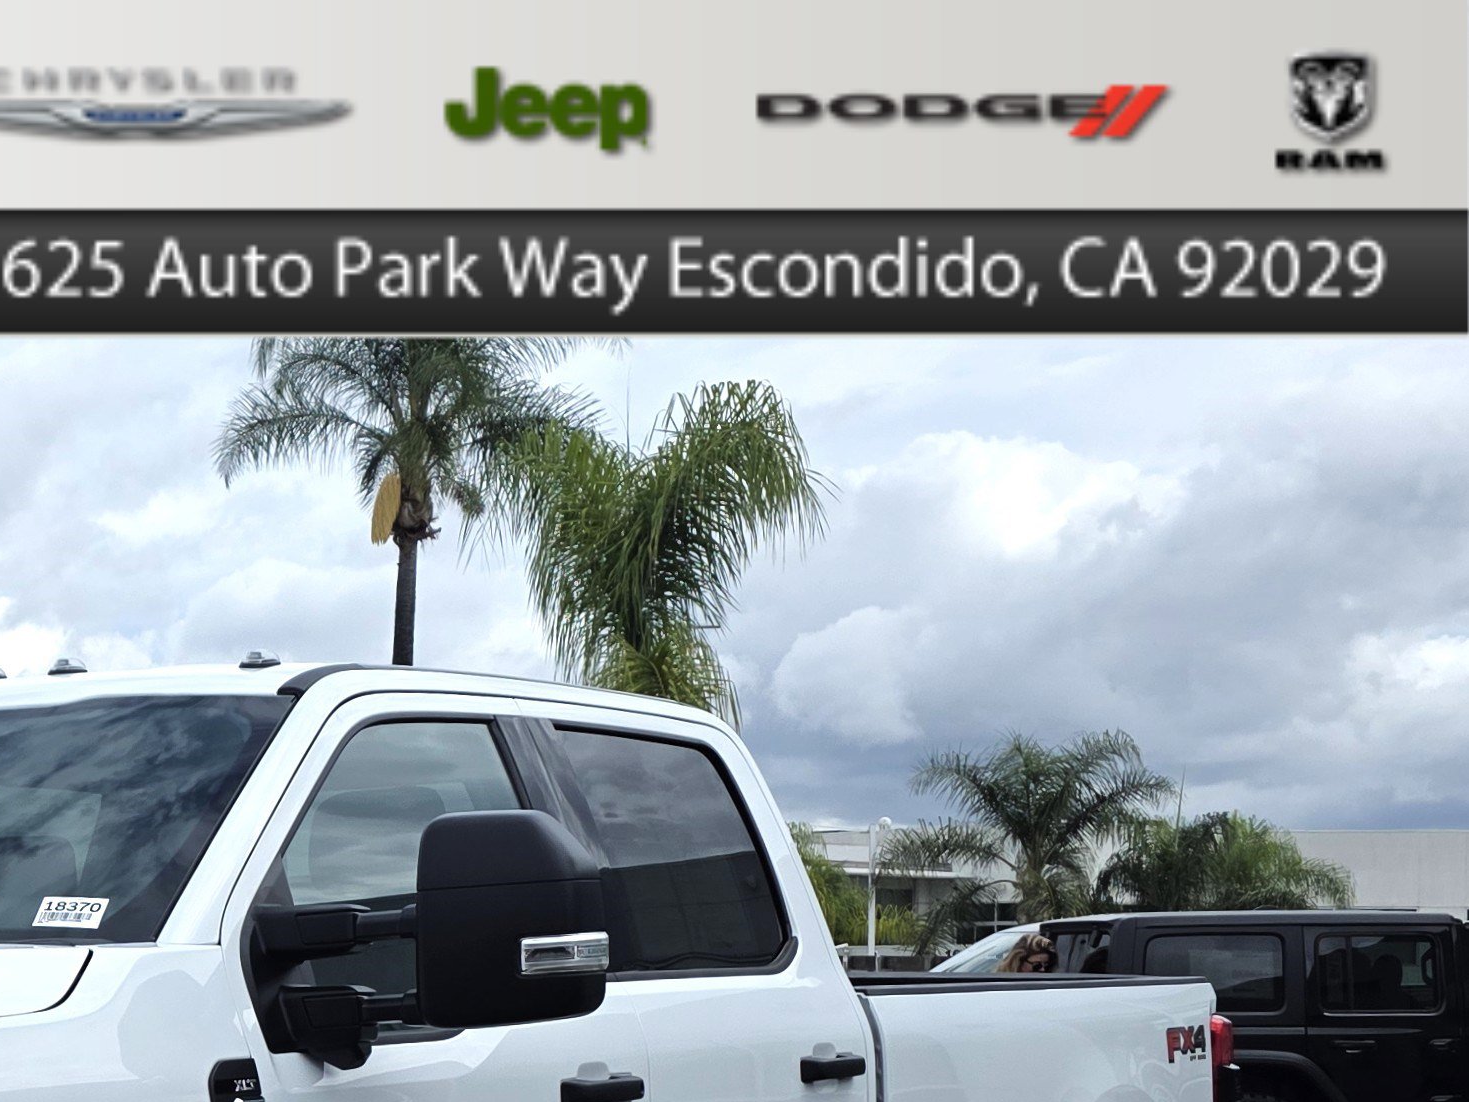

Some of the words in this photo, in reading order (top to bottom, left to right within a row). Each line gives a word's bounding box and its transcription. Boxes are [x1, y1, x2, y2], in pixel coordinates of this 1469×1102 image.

[43, 901, 102, 913] 18370
[1166, 1025, 1206, 1063] FX4
[233, 1079, 257, 1092] XLT
